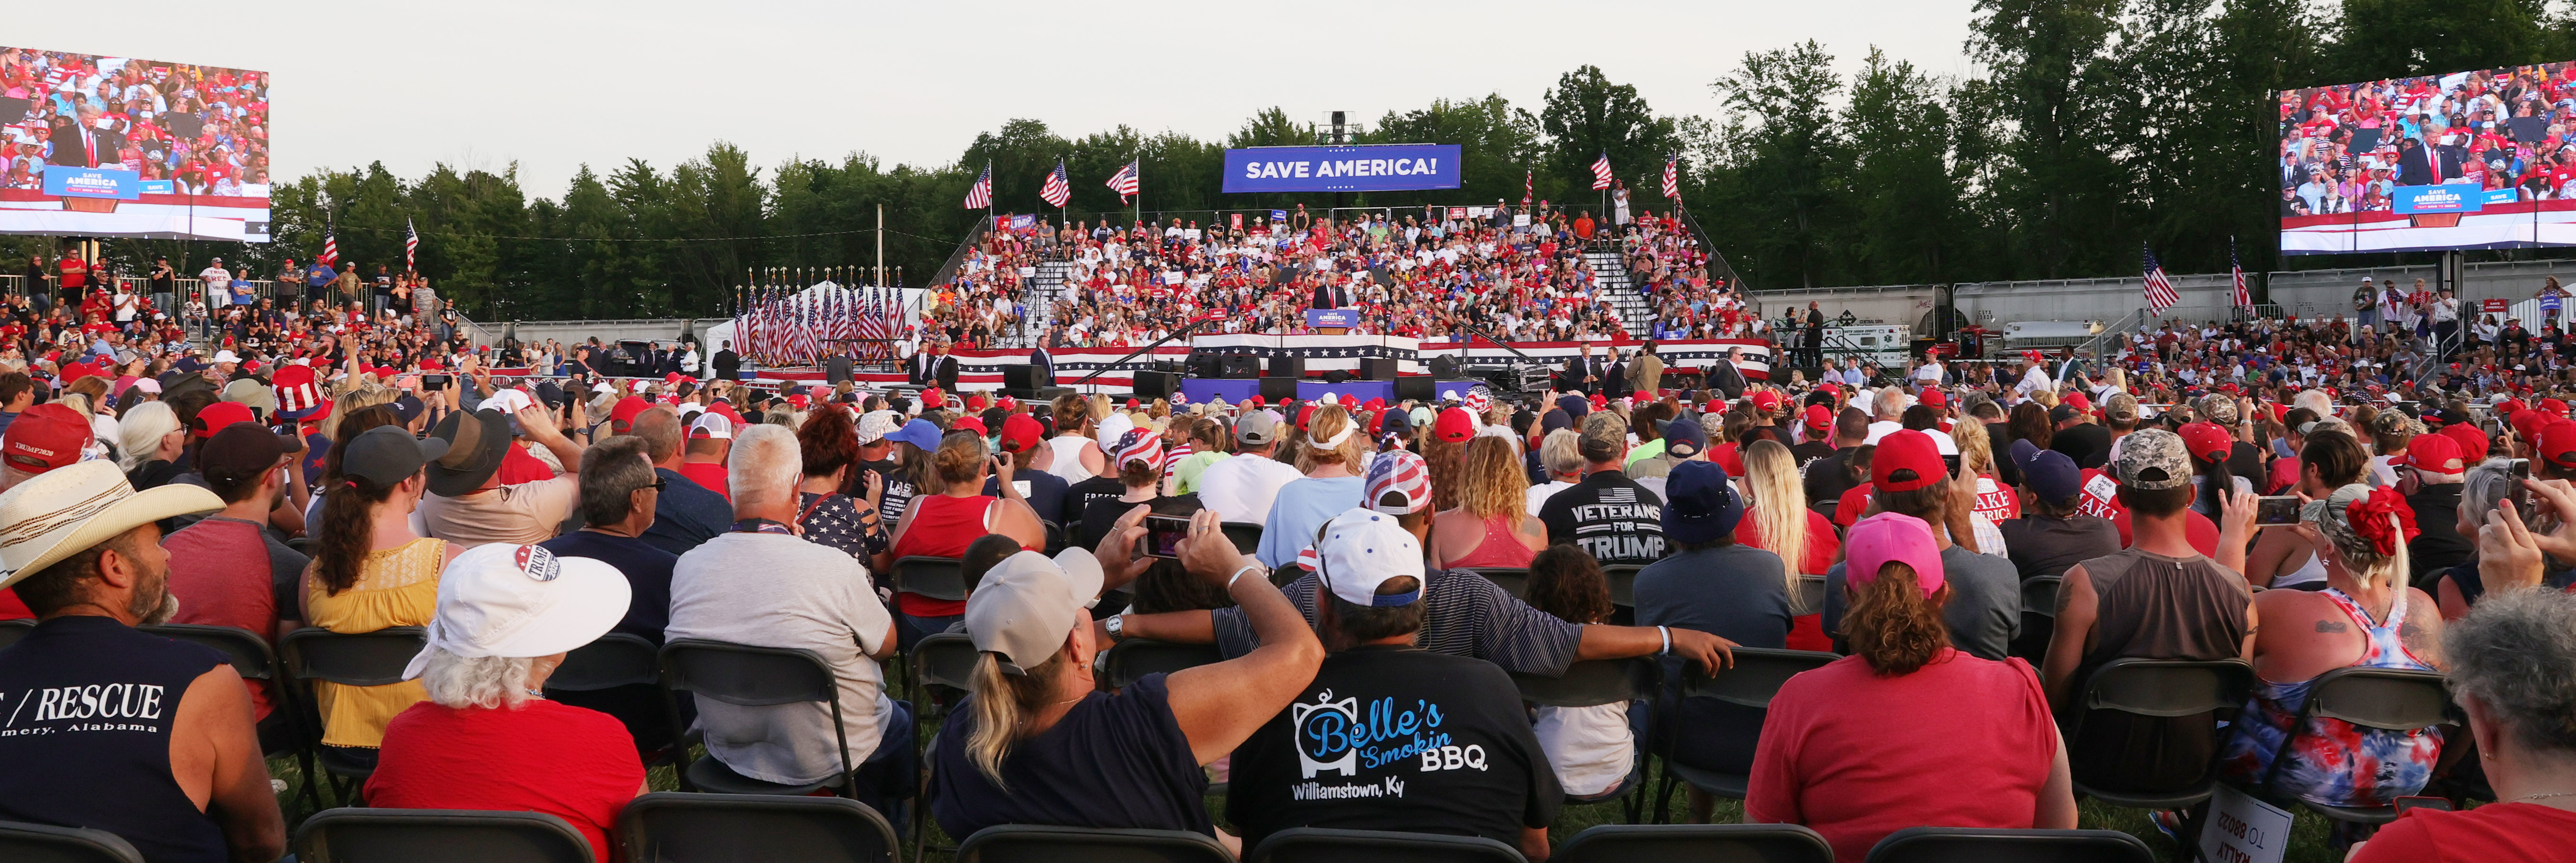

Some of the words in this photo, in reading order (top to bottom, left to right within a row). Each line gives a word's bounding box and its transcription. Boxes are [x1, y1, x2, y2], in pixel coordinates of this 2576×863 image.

[1245, 161, 1310, 179] SAVE
[1315, 157, 1437, 178] AMERICA!
[66, 177, 118, 187] AMERICA
[2413, 194, 2462, 203] AMERICA
[15, 441, 54, 457] TRUMP2020
[2100, 477, 2112, 488] Save
[1973, 490, 2009, 510] AKE
[2086, 484, 2109, 502] Children
[1571, 503, 1661, 523] VETERANS
[1976, 507, 2012, 521] ERICA
[1613, 521, 1635, 532] FOR
[1577, 534, 1665, 561] TRUMP
[528, 546, 548, 577] TRUMP
[547, 560, 560, 578] 2020
[35, 683, 164, 722] RESCUE
[67, 722, 158, 733] Alabama
[1307, 696, 1445, 757] Belle's
[1360, 731, 1452, 769] Smokin
[1420, 744, 1489, 773] BBQ
[1292, 782, 1383, 801] Williamstown,
[1385, 775, 1405, 799] Ky
[2217, 811, 2248, 840] 88022
[2249, 827, 2265, 850] TO
